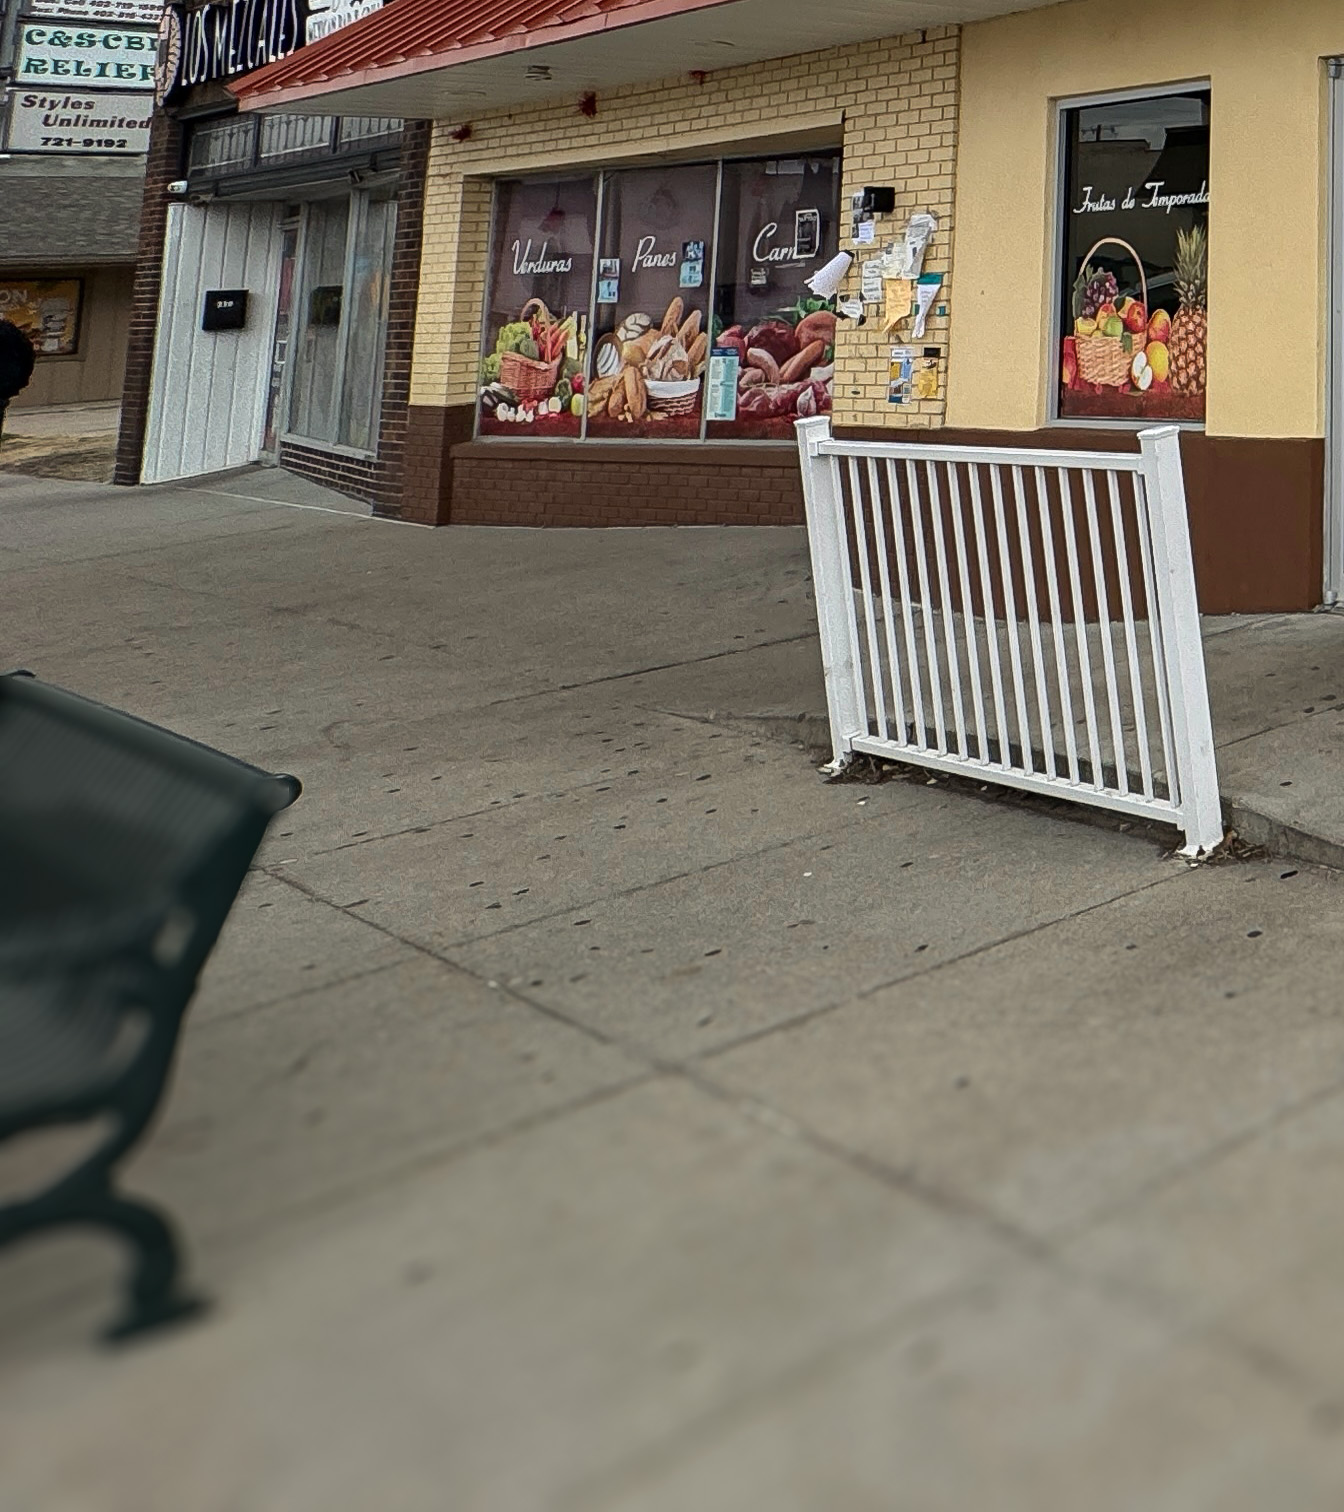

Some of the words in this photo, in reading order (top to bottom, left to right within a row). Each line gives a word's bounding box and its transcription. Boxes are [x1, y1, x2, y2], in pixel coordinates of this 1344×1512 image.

[21, 94, 96, 111] Styles
[42, 114, 152, 129] Unlimited
[1073, 186, 1116, 214] Frutas
[1121, 186, 1136, 210] de
[1141, 180, 1210, 215] Temporada
[512, 238, 573, 275] Verduras
[631, 236, 678, 273] Panes
[753, 222, 799, 263] Carn
